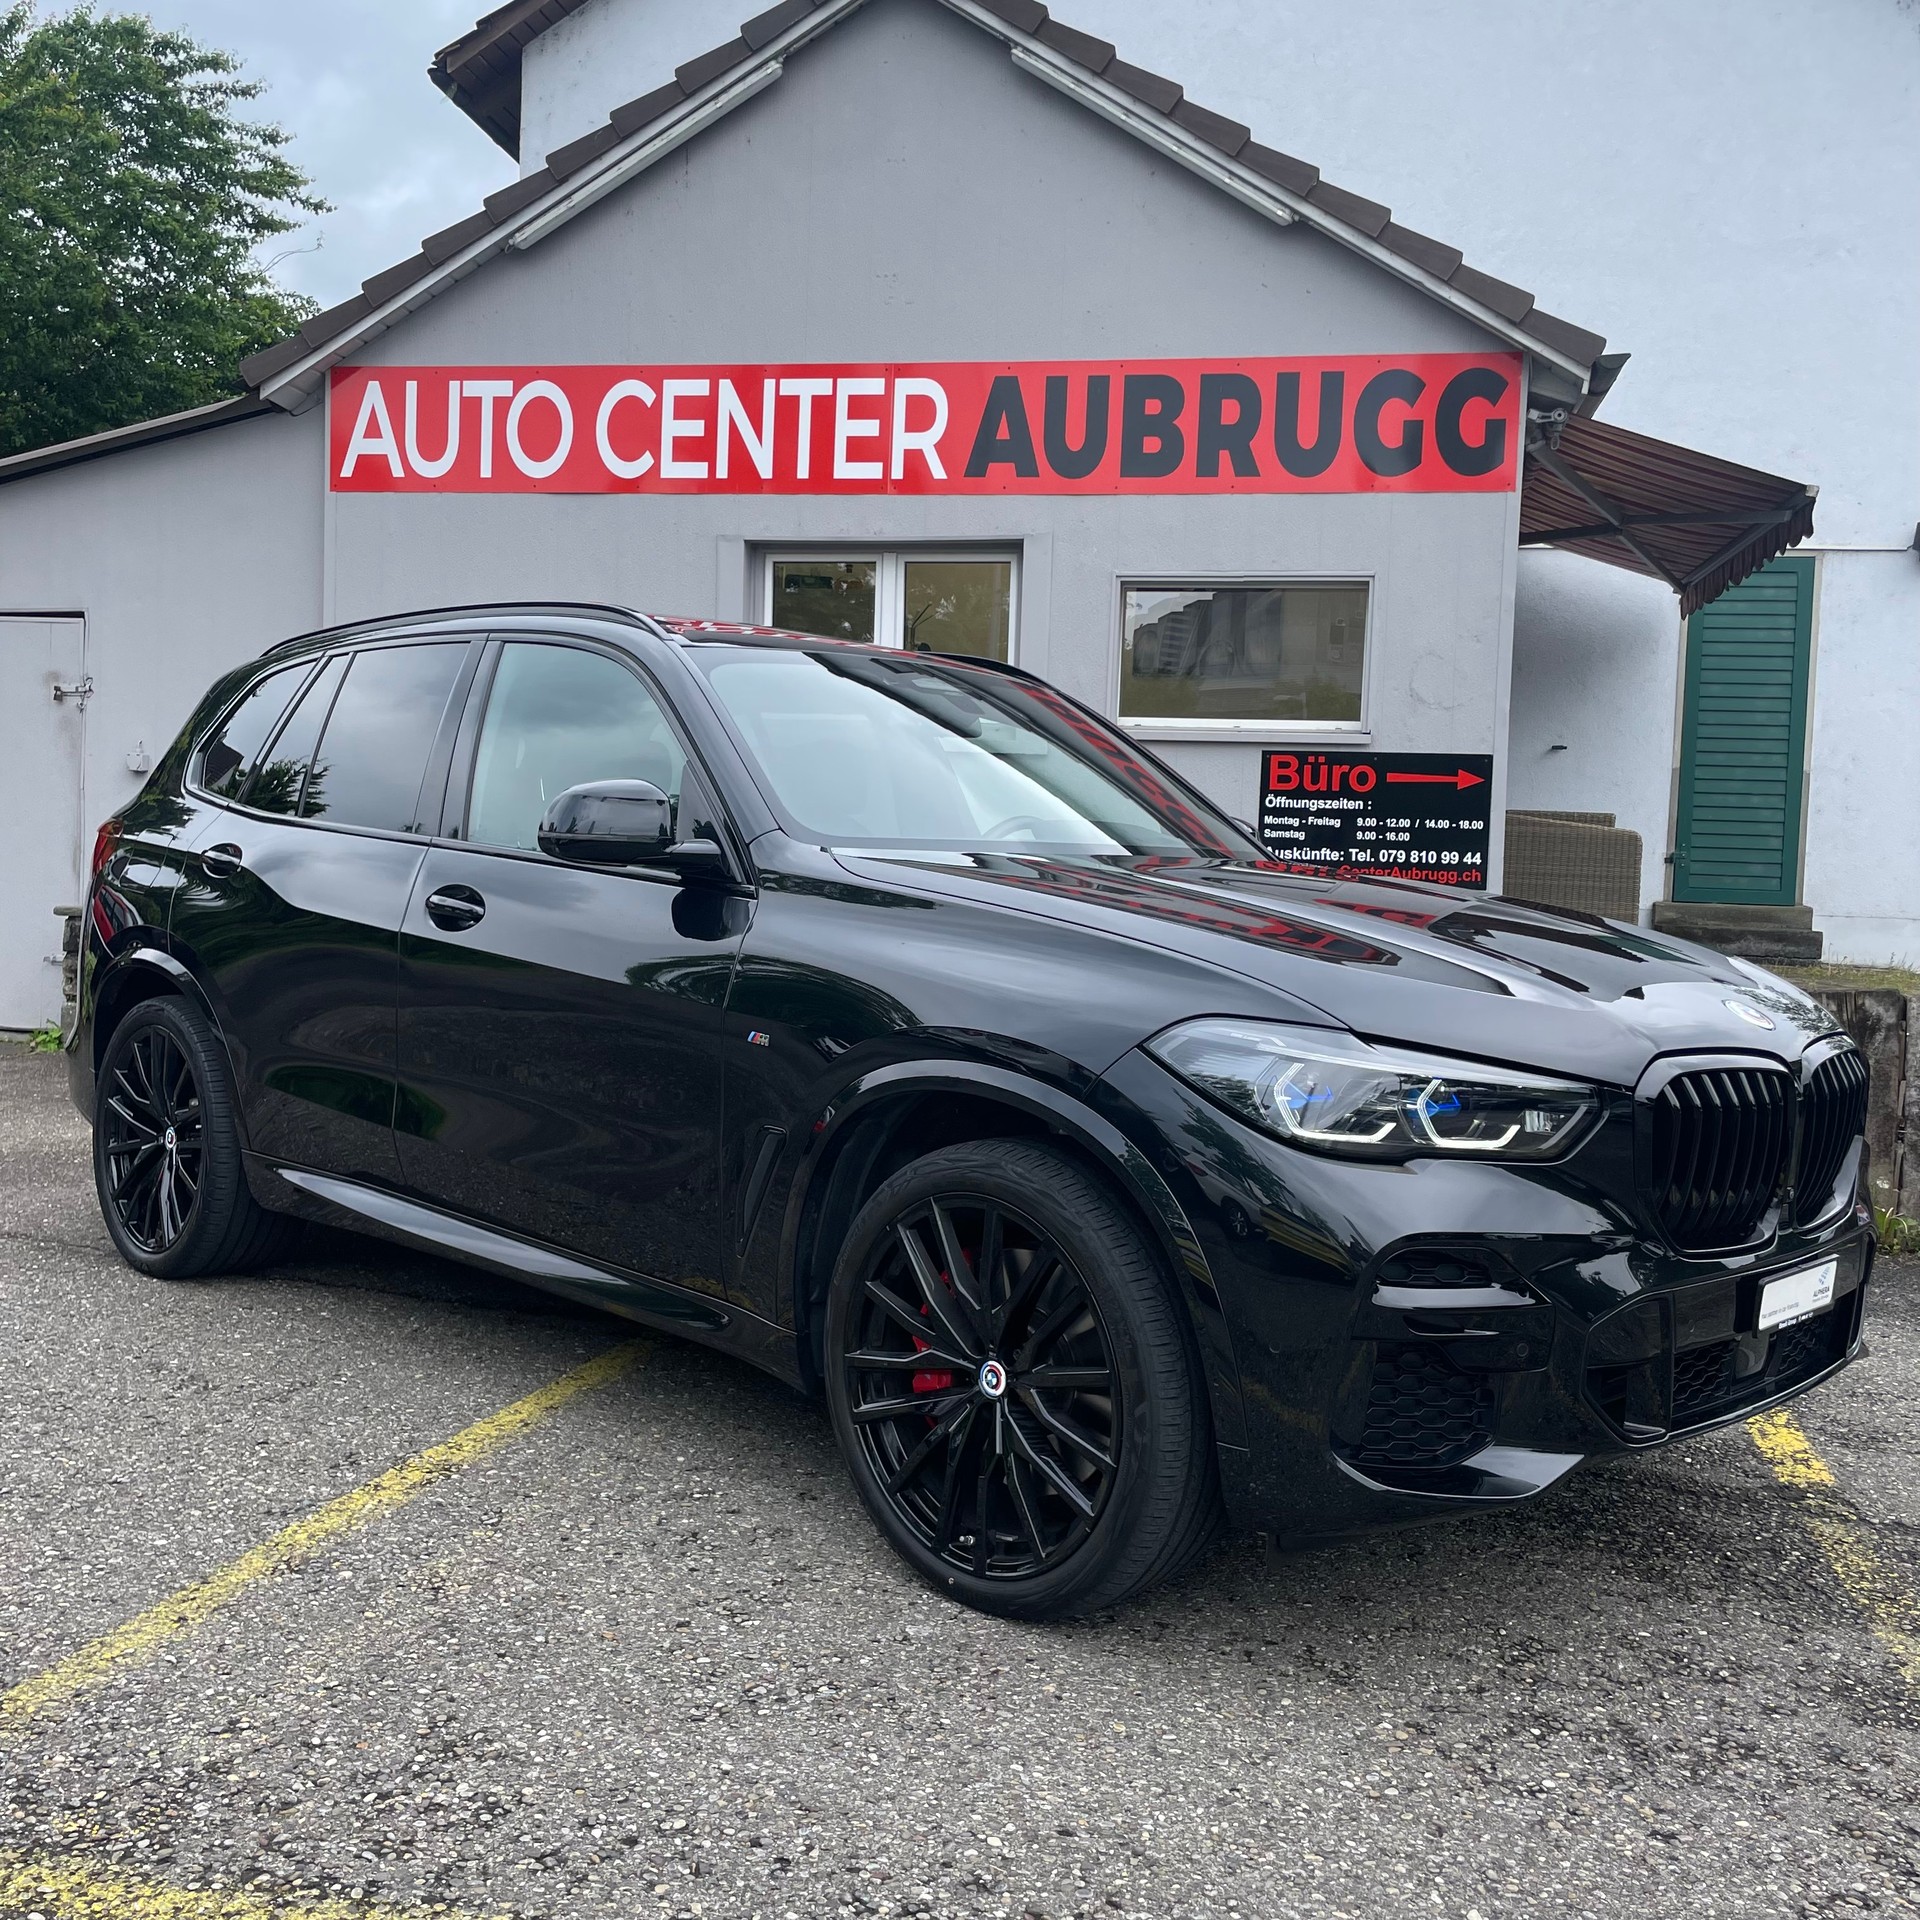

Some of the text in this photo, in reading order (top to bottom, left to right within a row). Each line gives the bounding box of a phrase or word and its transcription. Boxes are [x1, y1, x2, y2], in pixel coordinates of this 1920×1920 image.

[340, 368, 1509, 479] AUTO CENTER AUBRUGG
[1269, 754, 1377, 793] Büro
[1264, 794, 1363, 811] Öffnungszeiten
[1263, 815, 1299, 827] Montag
[1307, 816, 1341, 828] Freitag
[1356, 817, 1376, 827] 9.00
[1385, 818, 1411, 828] 12.00
[1424, 819, 1450, 829] 14.00
[1458, 820, 1484, 830] 18.00
[1263, 828, 1305, 840] Samstag
[1356, 831, 1376, 841] 9.00
[1385, 832, 1411, 842] 16.00
[1349, 849, 1375, 862] Tel.
[1379, 849, 1406, 863] 079
[1409, 850, 1437, 864] 810
[1440, 851, 1460, 865] 99
[1462, 852, 1482, 866] 44
